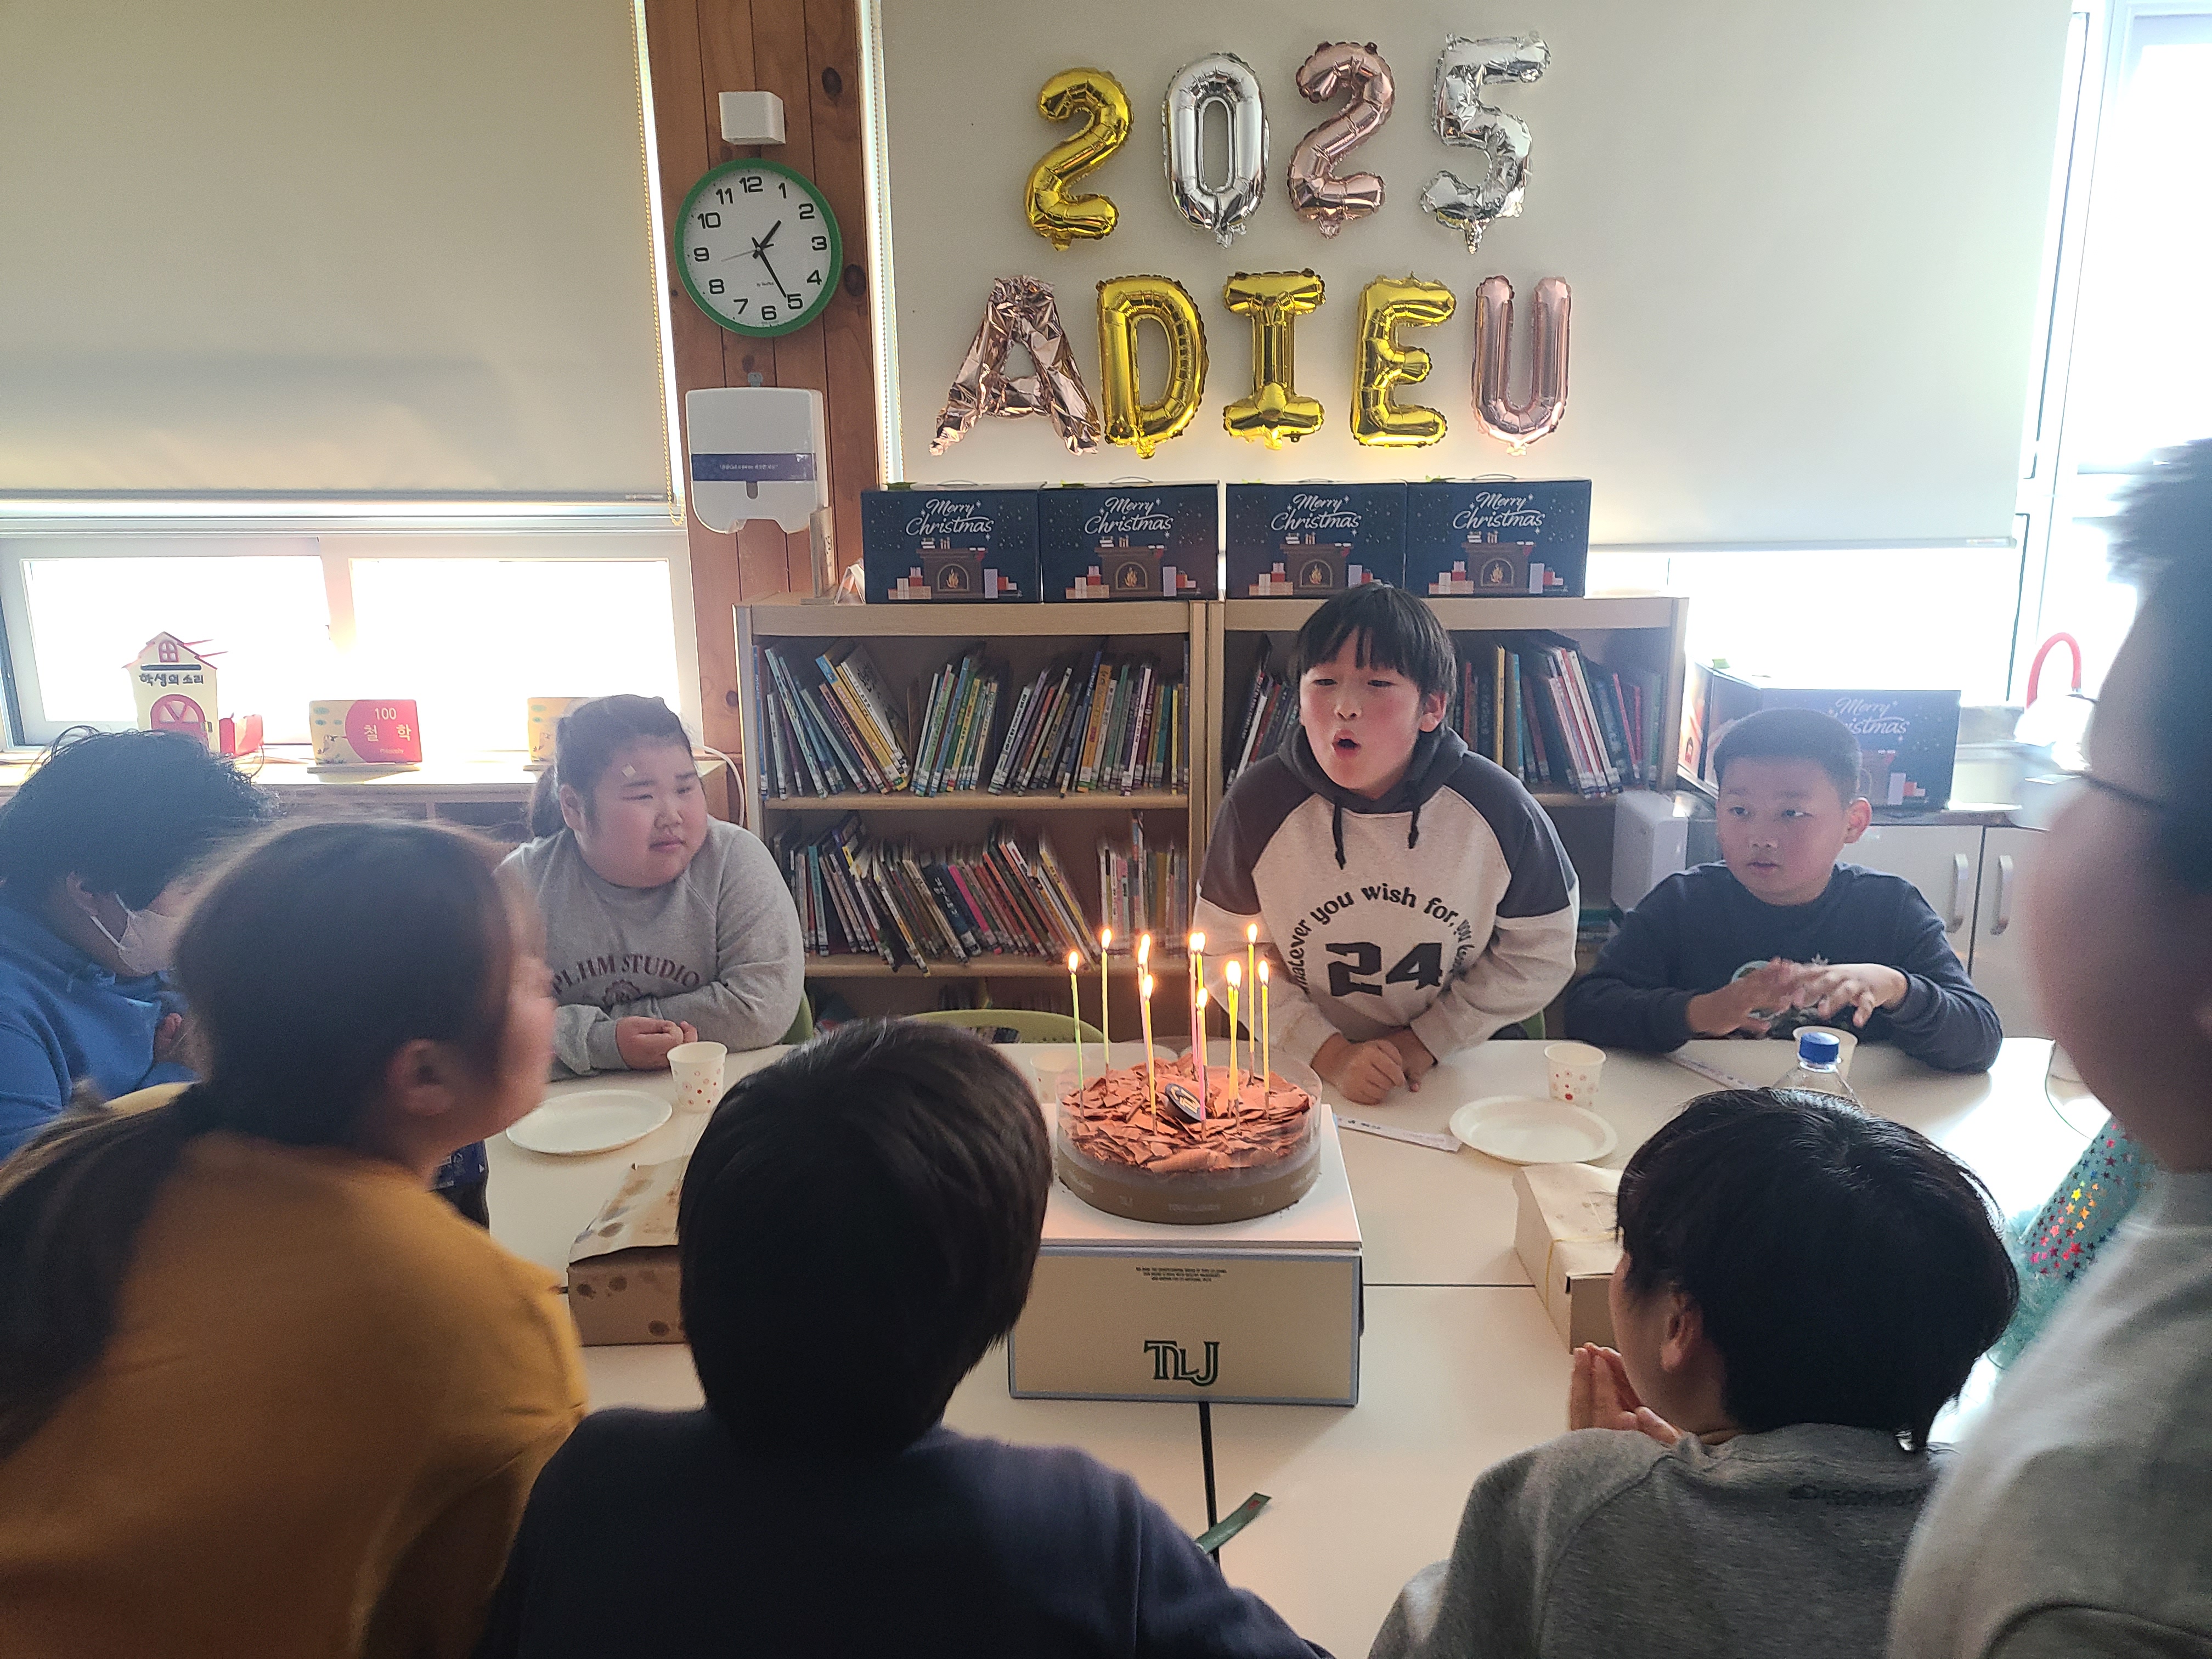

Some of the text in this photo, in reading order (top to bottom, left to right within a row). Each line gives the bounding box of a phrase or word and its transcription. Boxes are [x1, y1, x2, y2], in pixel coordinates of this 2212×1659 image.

[1024, 32, 1552, 252] 2025
[739, 176, 764, 193] 12
[778, 182, 787, 199] 1
[716, 188, 734, 205] 11
[799, 203, 815, 219] 2
[697, 212, 721, 229] 10
[811, 235, 827, 251] 3
[693, 247, 710, 262] 9
[807, 269, 822, 285] 4
[709, 279, 725, 294] 8
[733, 298, 748, 314] 7
[787, 293, 803, 310] 5
[761, 306, 777, 320] 6
[929, 268, 1572, 459] ADIEU
[926, 498, 975, 517] Merry
[1105, 496, 1154, 515] Merry
[1293, 493, 1342, 512] Merry
[1475, 491, 1527, 510] Merry
[906, 515, 995, 536] Christmas
[1084, 514, 1174, 535] Christmas
[1271, 510, 1362, 532] Christmas
[1453, 508, 1545, 530] Christmas
[138, 673, 204, 687] 학생의 소리
[375, 707, 397, 720] 100
[1835, 697, 1891, 718] Merry
[396, 724, 412, 741] 학
[1844, 716, 1911, 734] istmas
[1310, 891, 1354, 926] you
[1361, 883, 1418, 909] wish
[622, 952, 701, 988] STUDIO
[1325, 941, 1443, 997] 24
[1144, 1340, 1221, 1386] TLJ
